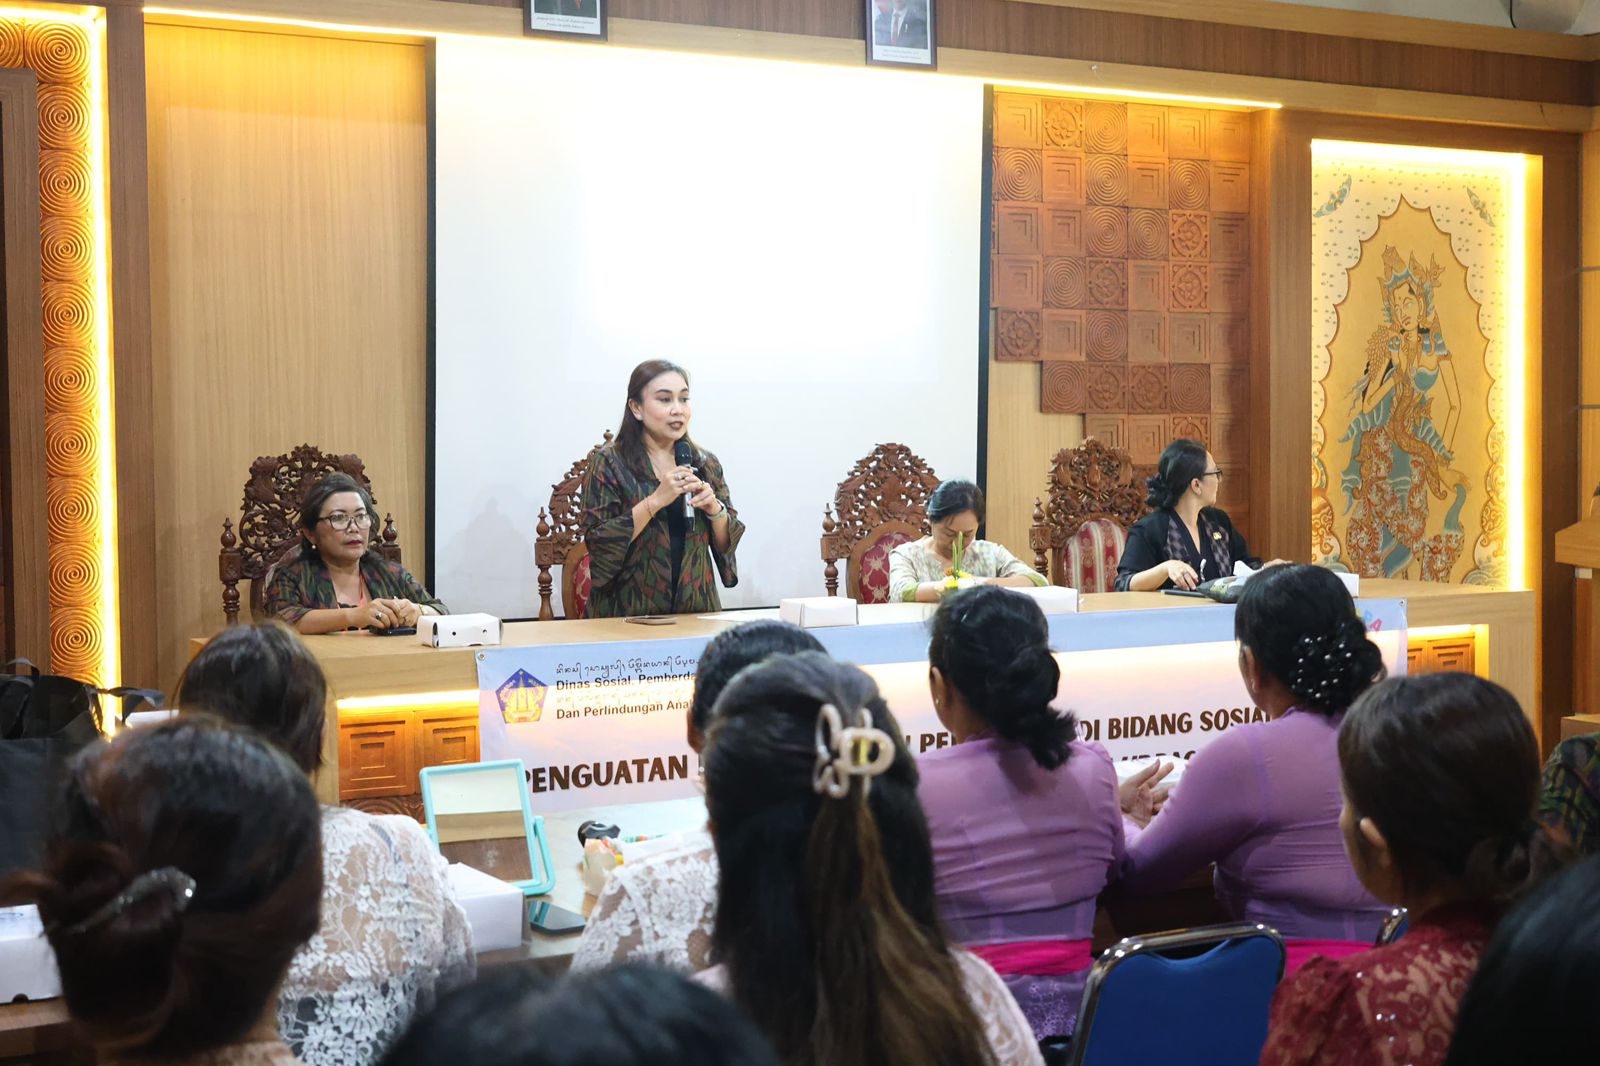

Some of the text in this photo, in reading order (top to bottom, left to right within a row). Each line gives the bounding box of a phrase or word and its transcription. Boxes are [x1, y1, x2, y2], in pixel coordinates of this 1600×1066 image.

[557, 680, 590, 690] Dinas
[557, 709, 580, 719] Dan
[584, 702, 663, 717] Perlindungan
[1108, 712, 1193, 740] BIDANG
